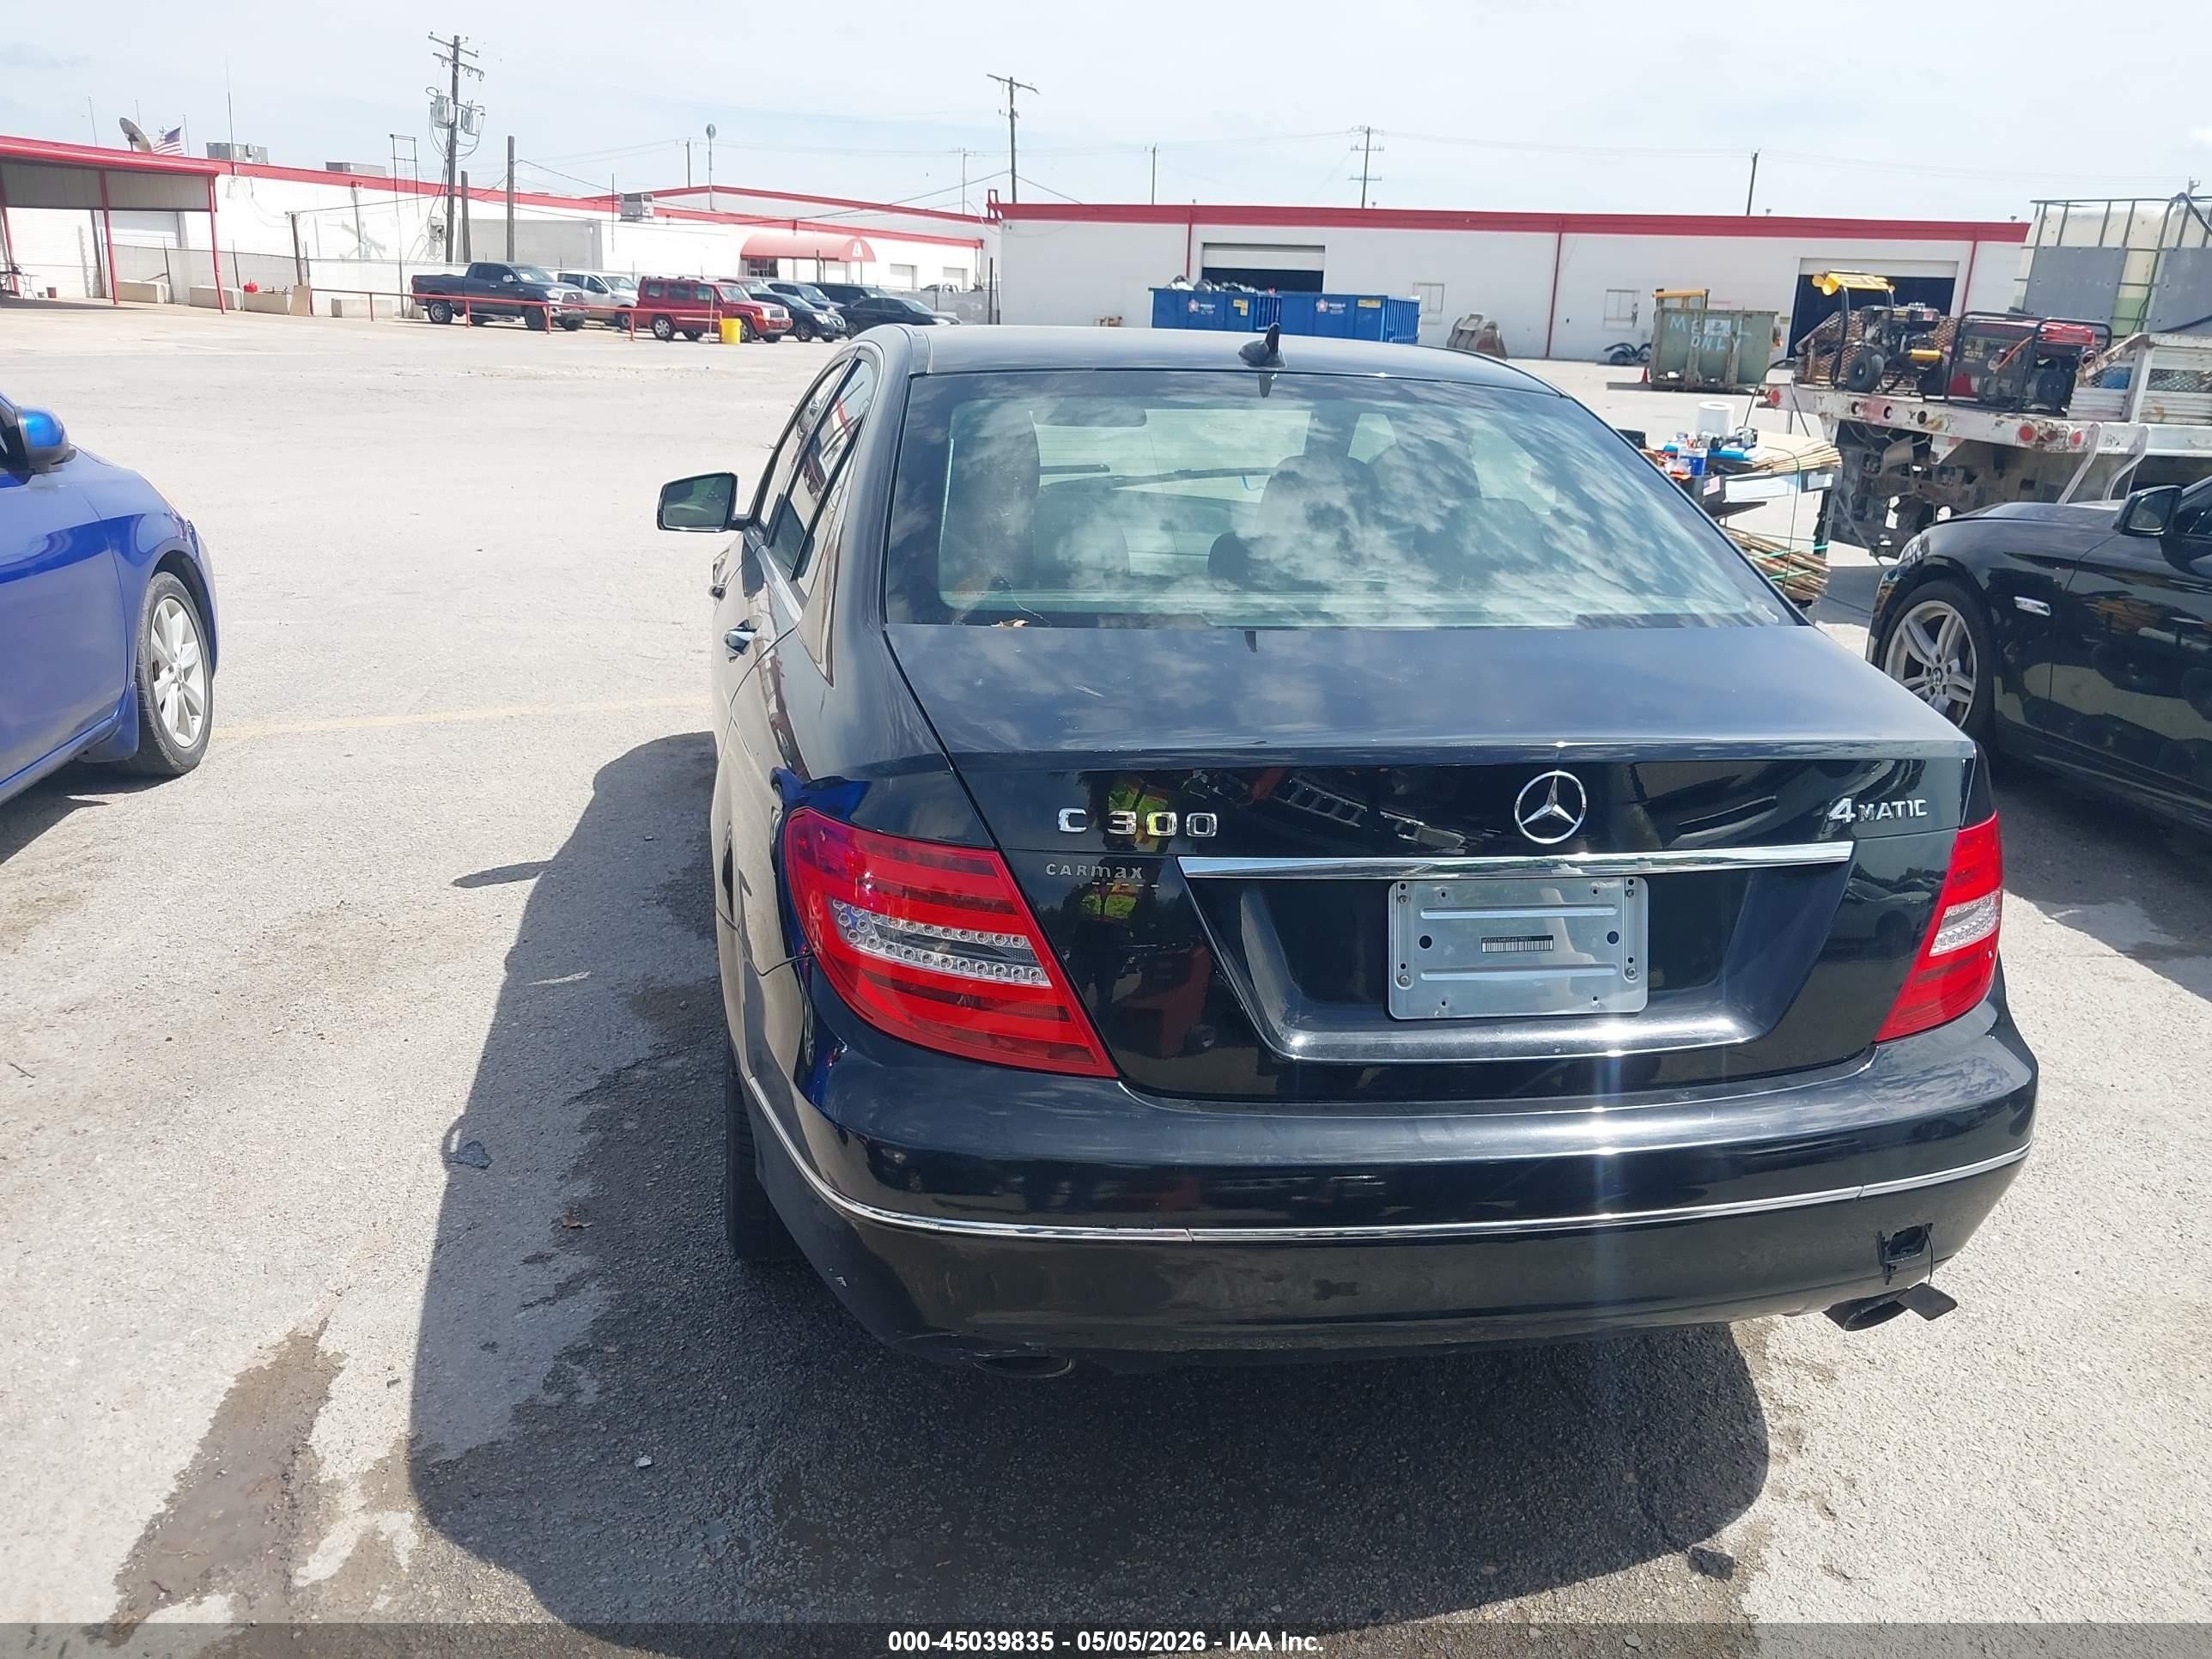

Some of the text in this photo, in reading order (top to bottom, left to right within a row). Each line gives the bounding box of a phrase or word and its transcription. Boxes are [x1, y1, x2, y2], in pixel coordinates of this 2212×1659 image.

[1669, 316, 1752, 335] MEL
[1691, 335, 1741, 354] ONLY
[1058, 808, 1218, 837] C 300
